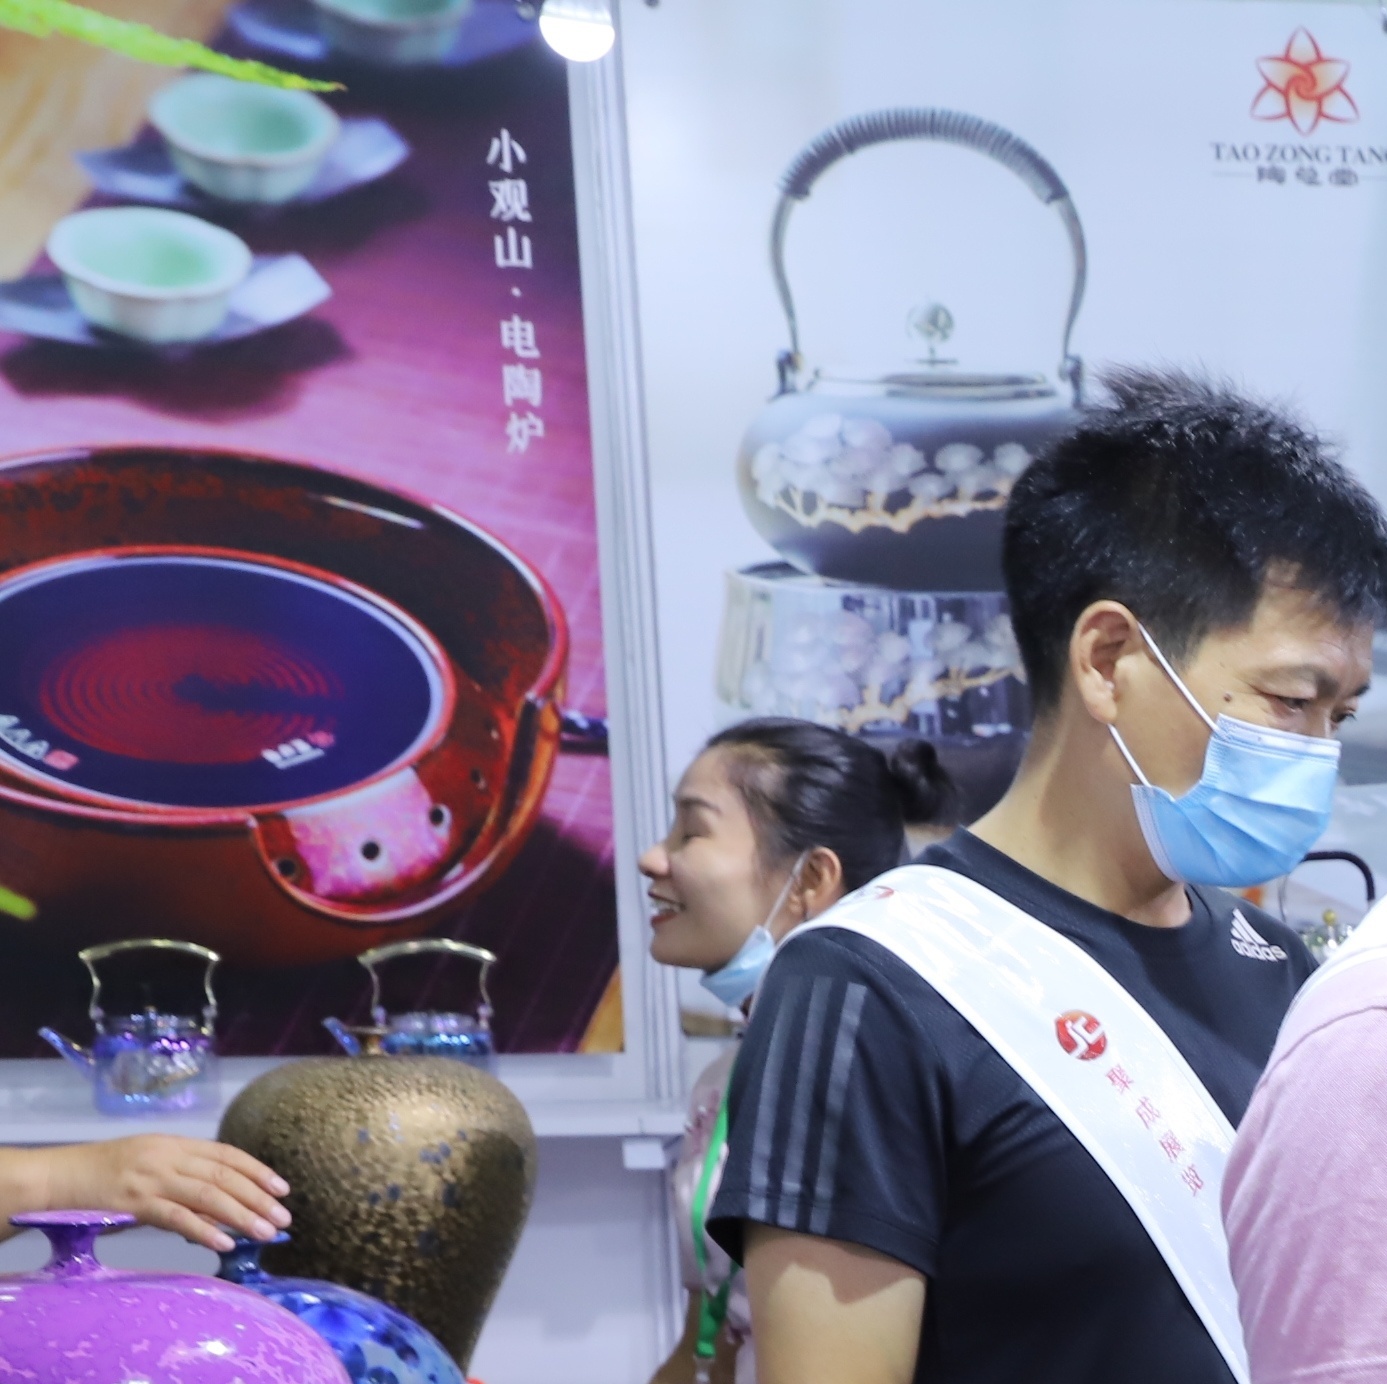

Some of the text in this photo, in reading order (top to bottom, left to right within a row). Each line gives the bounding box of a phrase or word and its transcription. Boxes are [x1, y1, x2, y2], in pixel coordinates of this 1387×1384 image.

[1210, 142, 1260, 162] TAO
[1265, 143, 1331, 164] ZONG
[485, 127, 545, 453] 小观山·电陶炉
[1231, 938, 1288, 963] adidas
